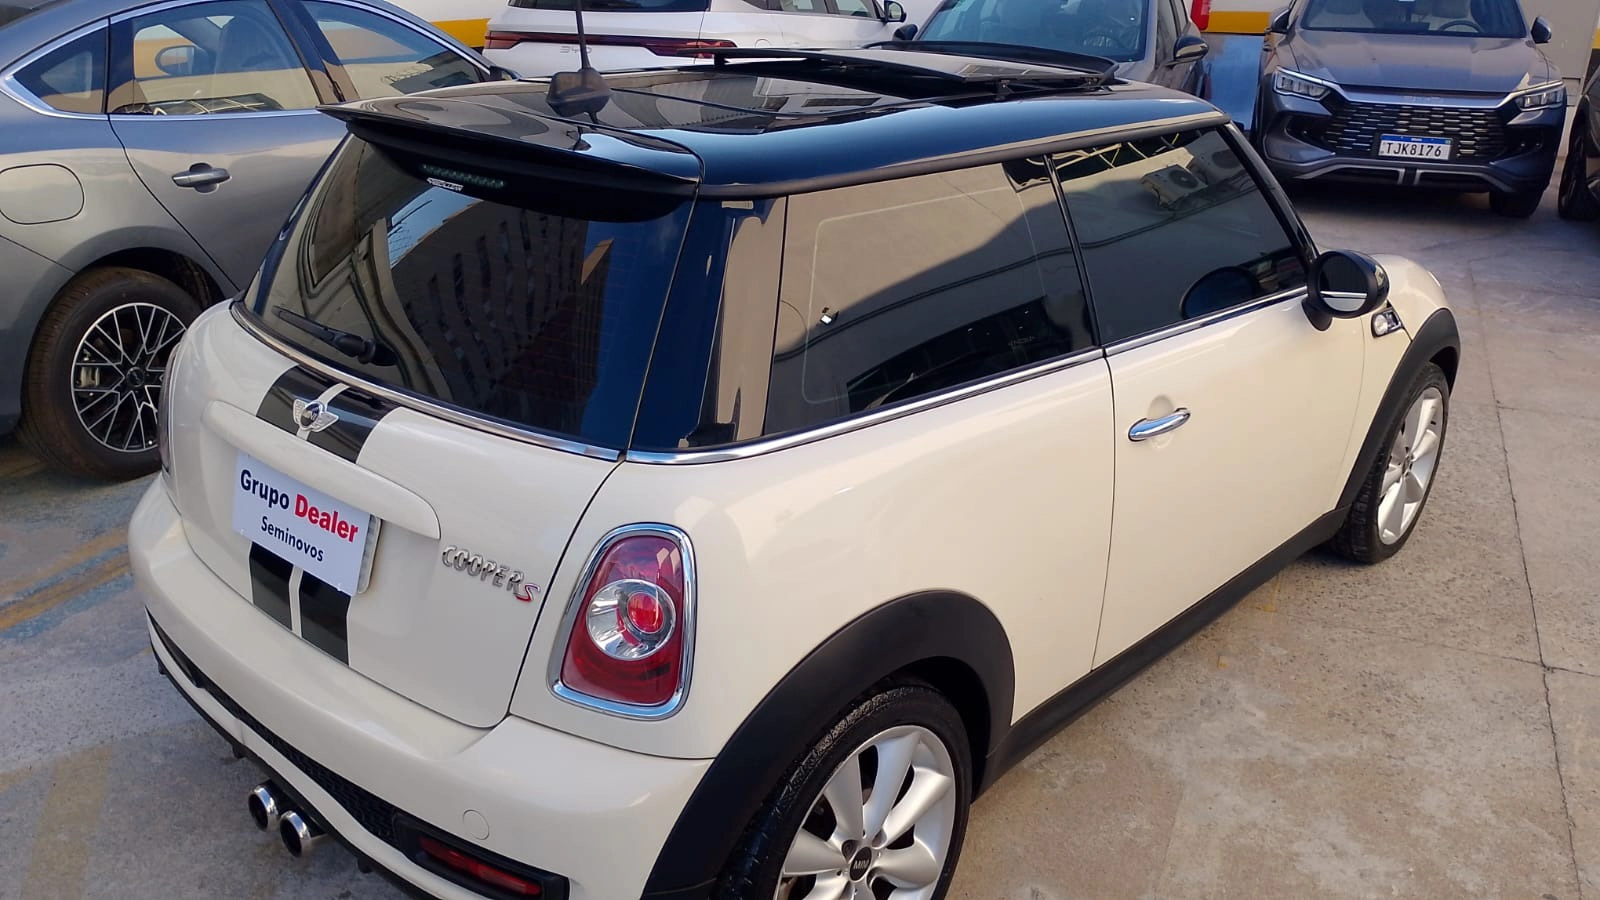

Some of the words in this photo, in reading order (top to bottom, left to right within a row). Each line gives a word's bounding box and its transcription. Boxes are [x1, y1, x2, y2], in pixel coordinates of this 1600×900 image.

[240, 469, 290, 510] Grupo
[294, 493, 359, 543] Dealer
[260, 515, 324, 562] Seminovos
[442, 545, 524, 591] COOPER
[513, 583, 541, 602] S
